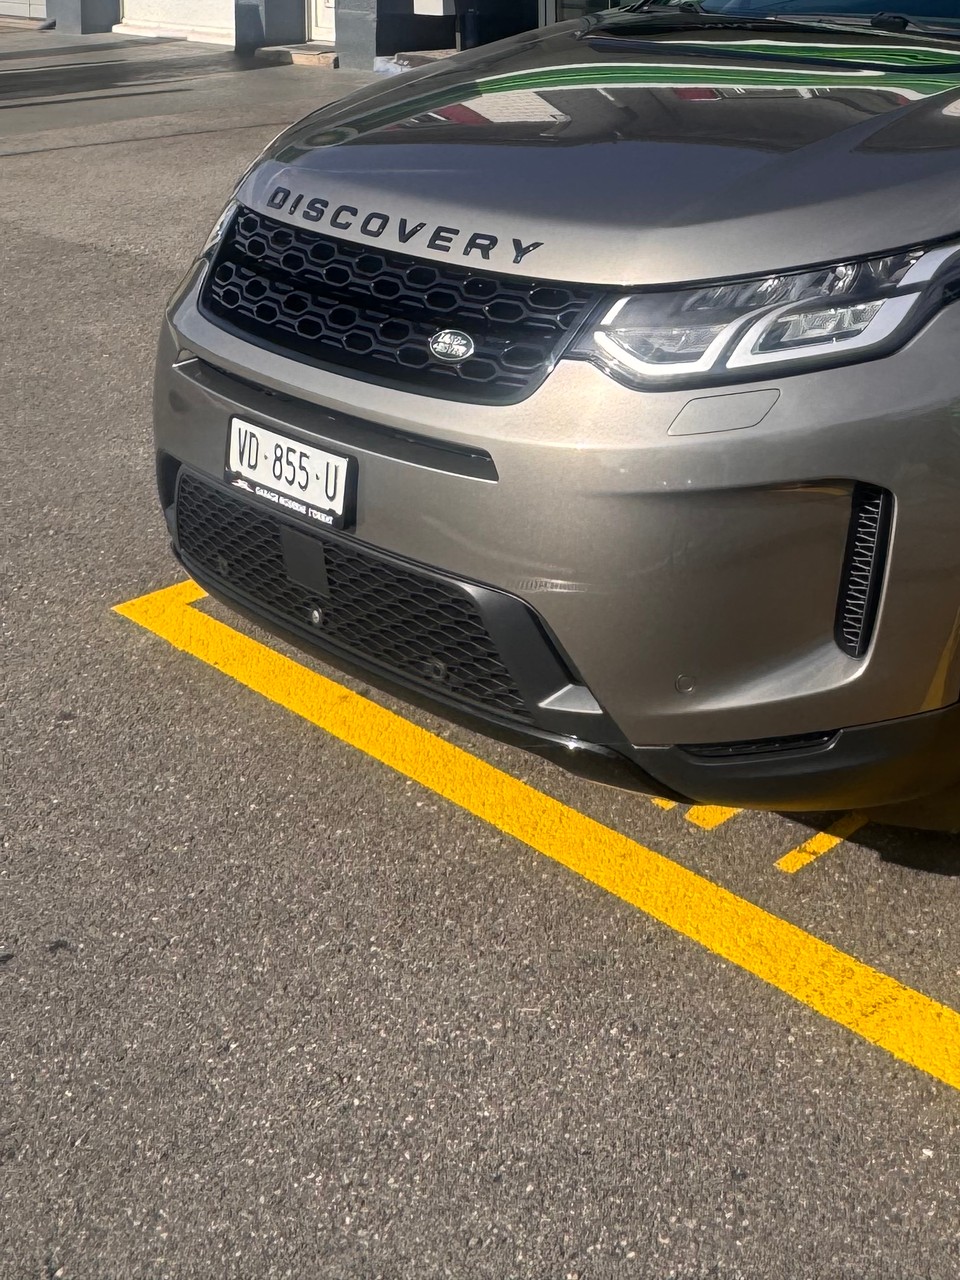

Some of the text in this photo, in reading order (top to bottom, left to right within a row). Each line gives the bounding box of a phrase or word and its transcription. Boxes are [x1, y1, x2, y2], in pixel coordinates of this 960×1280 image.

[266, 186, 544, 265] DISCOVERY
[237, 427, 259, 472] VD
[272, 444, 311, 492] 855
